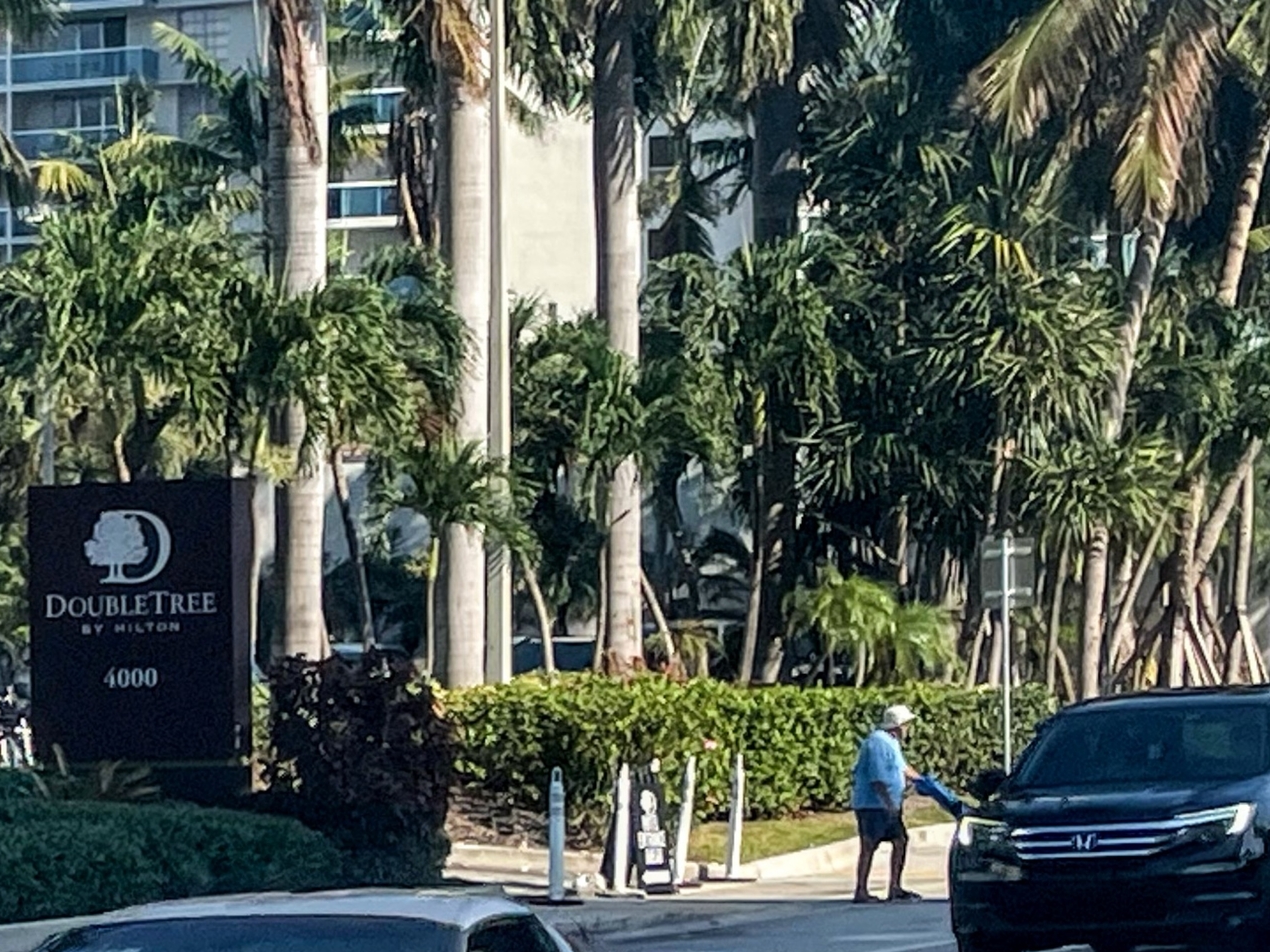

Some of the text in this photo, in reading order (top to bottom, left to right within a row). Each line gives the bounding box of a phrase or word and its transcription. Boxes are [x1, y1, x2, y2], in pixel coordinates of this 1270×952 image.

[81, 621, 180, 635] BY HILTON
[103, 667, 158, 688] 4000
